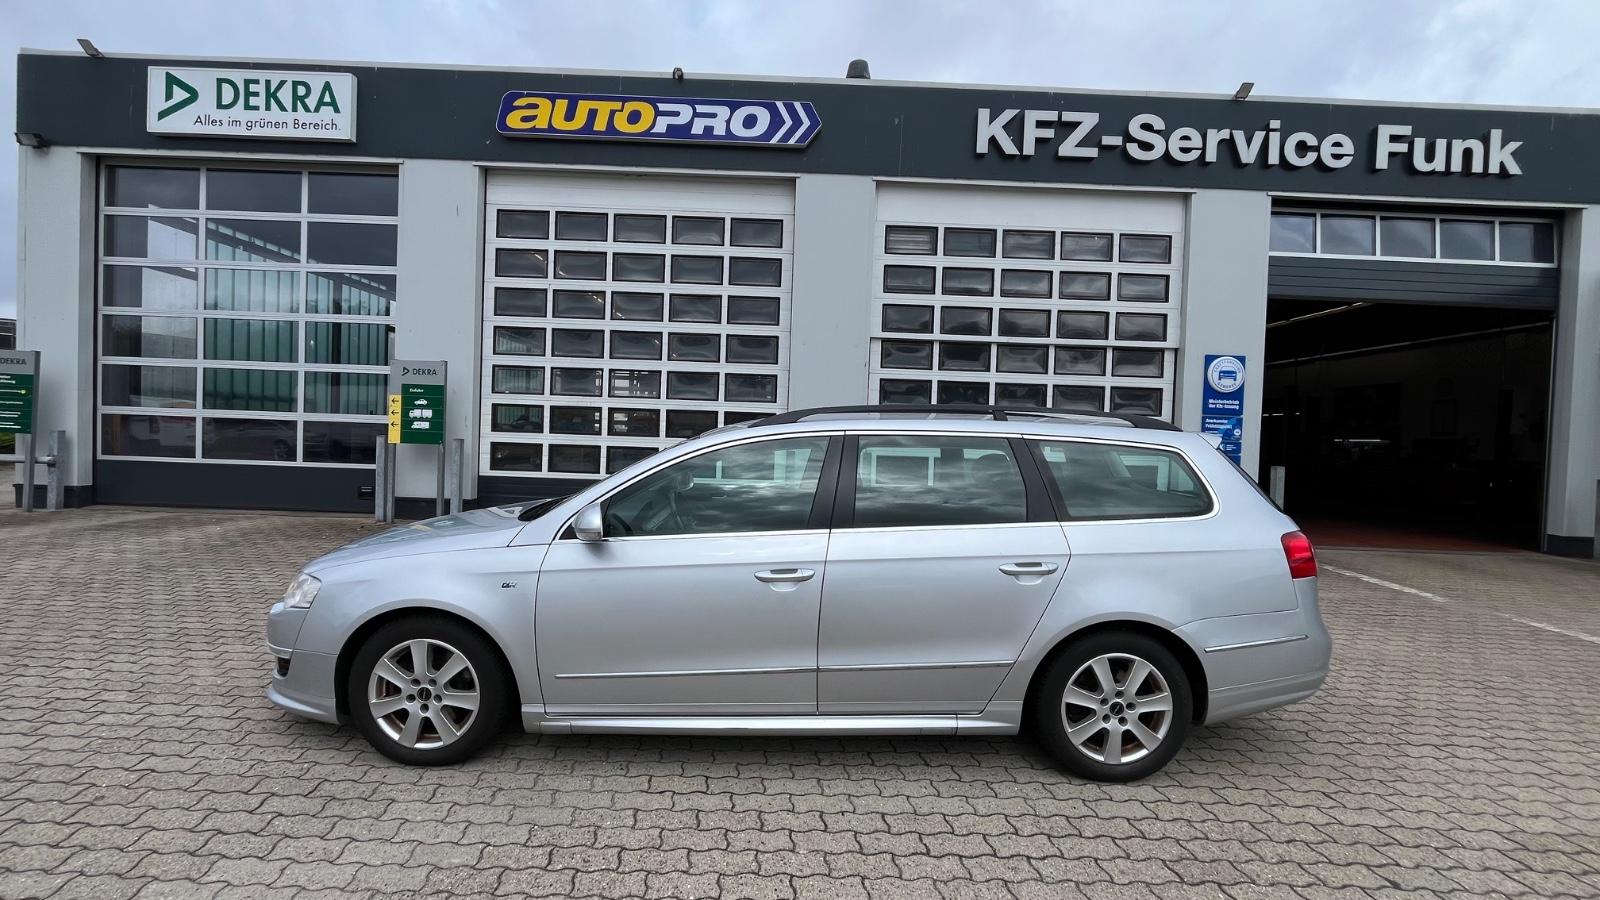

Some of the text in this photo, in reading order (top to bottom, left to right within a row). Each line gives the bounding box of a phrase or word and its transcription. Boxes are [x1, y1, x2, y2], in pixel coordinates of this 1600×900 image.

[215, 77, 341, 114] DEKRA
[193, 115, 341, 132] Alles im grünen Bereich.
[975, 108, 1524, 176] KFZ-Service Funk
[412, 368, 438, 376] DEKRA
